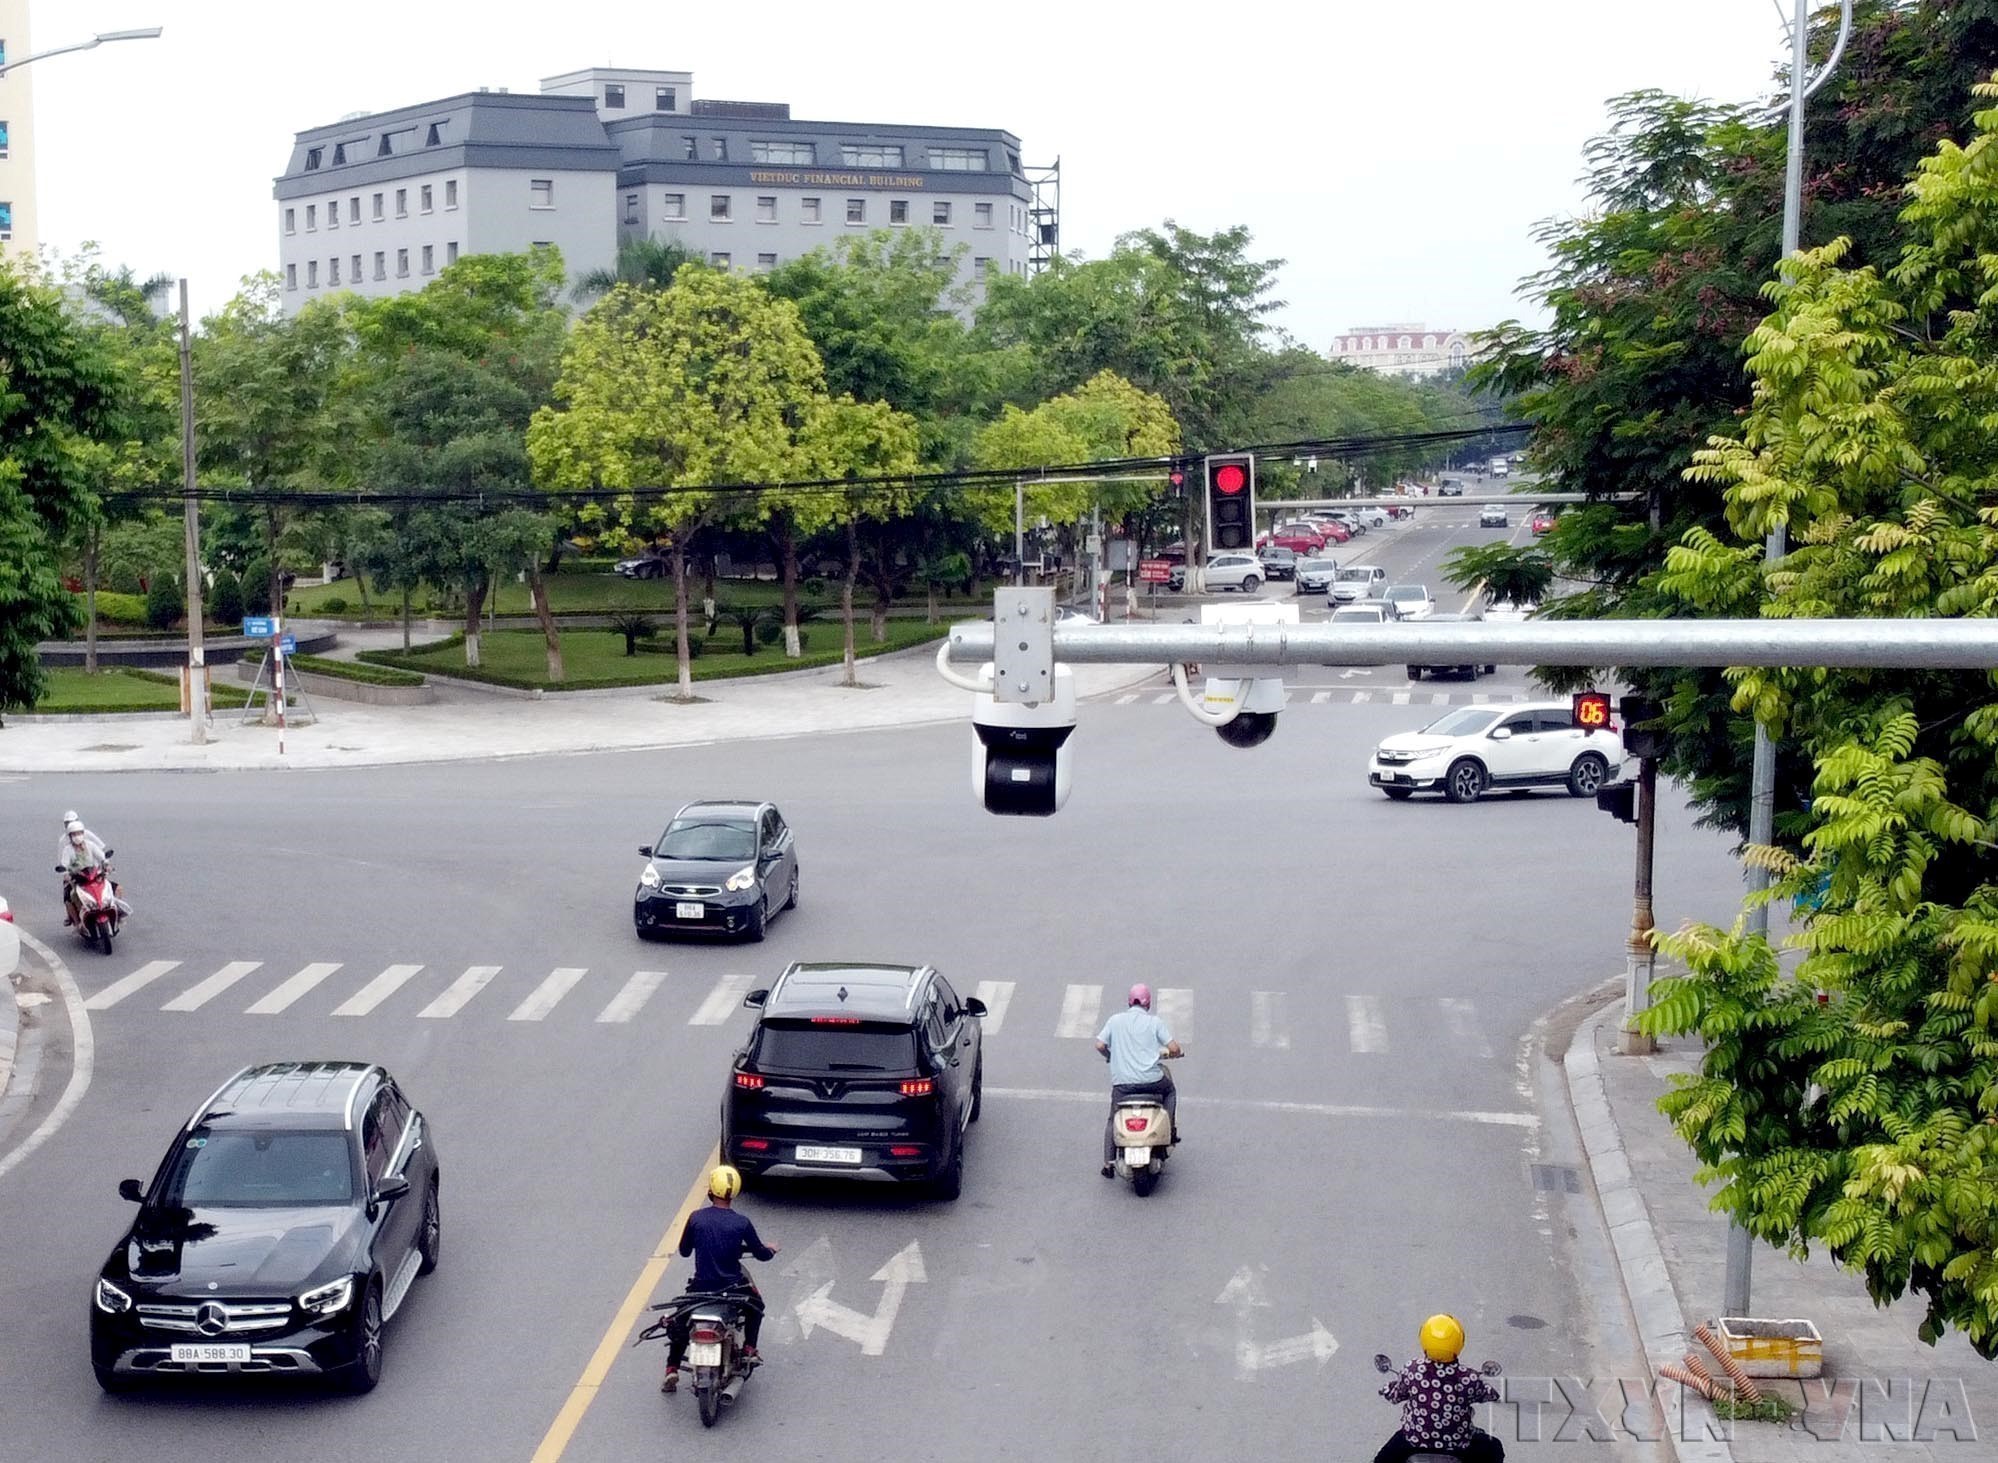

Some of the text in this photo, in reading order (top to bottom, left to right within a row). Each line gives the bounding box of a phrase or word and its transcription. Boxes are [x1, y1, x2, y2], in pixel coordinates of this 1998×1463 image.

[751, 172, 923, 187] VIETDUC FINANCIAL BUILDING
[1580, 701, 1604, 724] 06
